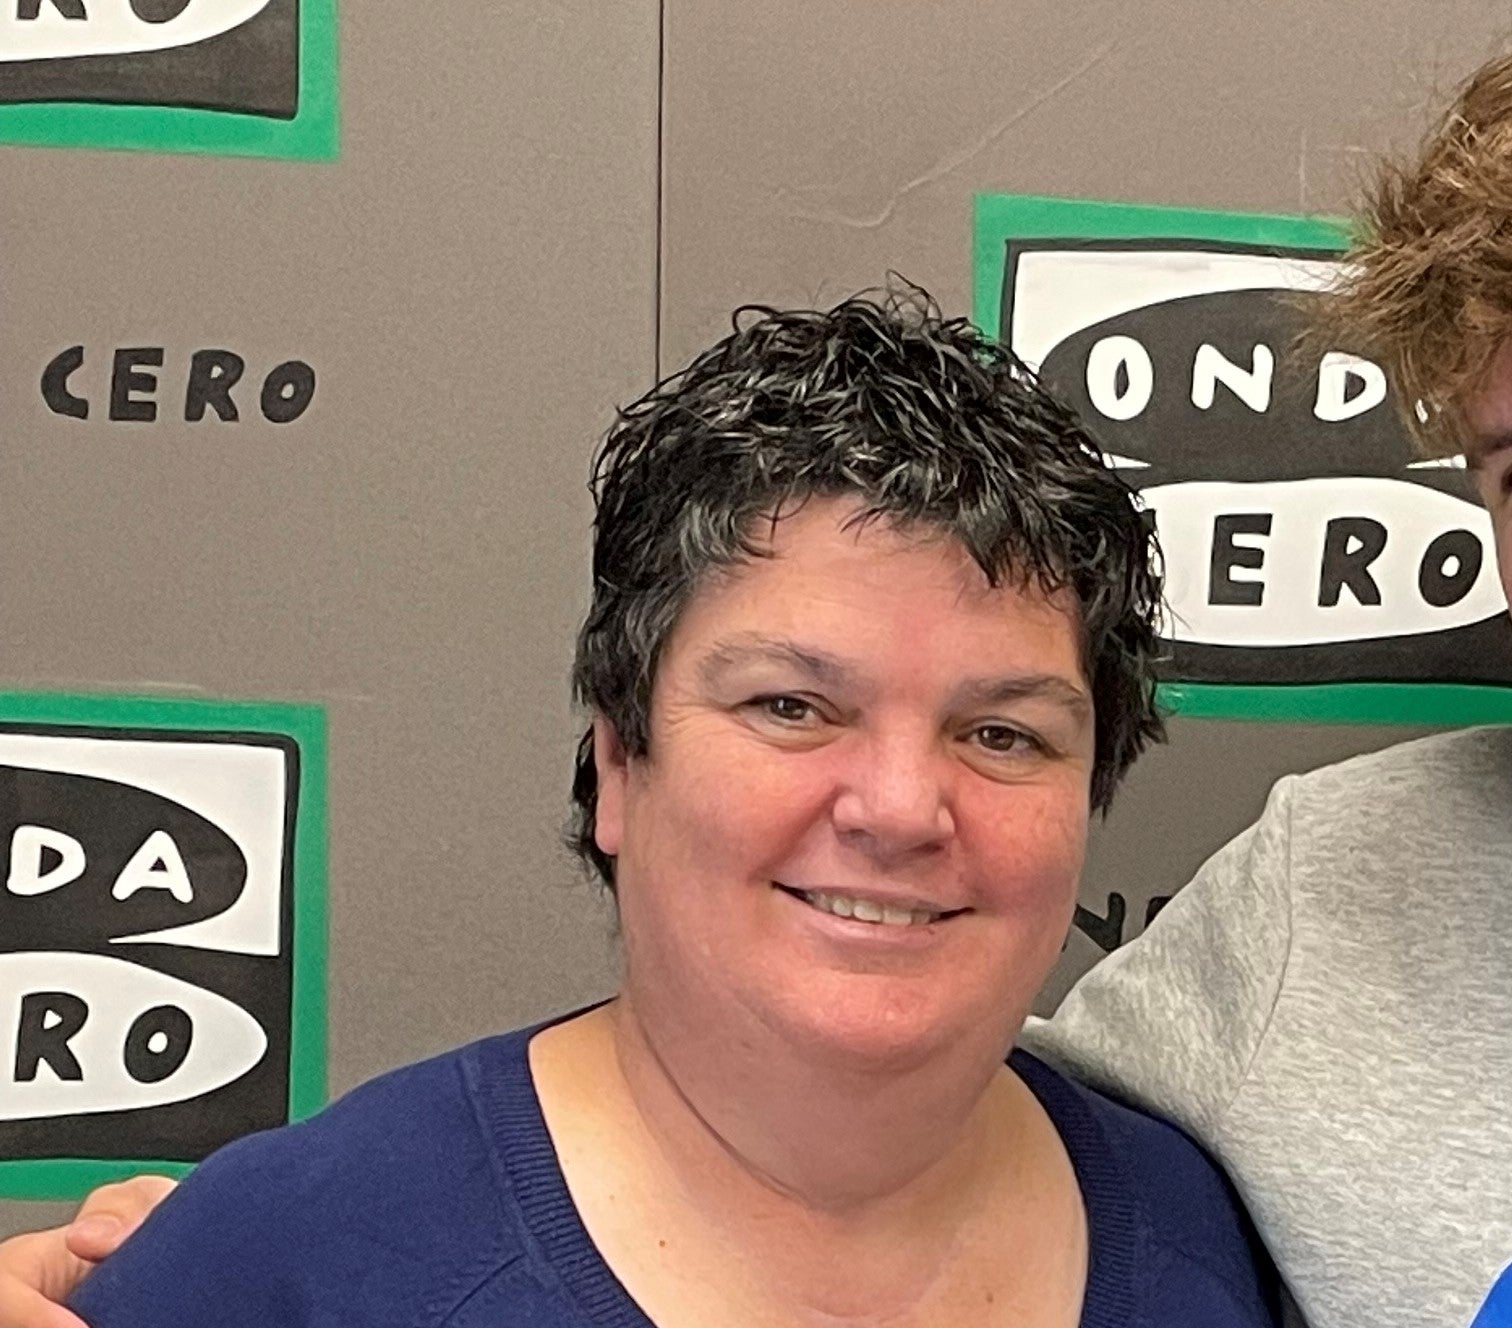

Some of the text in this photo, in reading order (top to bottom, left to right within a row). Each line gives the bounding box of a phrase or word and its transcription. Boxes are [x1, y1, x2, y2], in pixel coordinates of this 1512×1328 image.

[40, 345, 316, 424] CERO
[1086, 335, 1441, 421] OND
[1140, 508, 1484, 607] ERO
